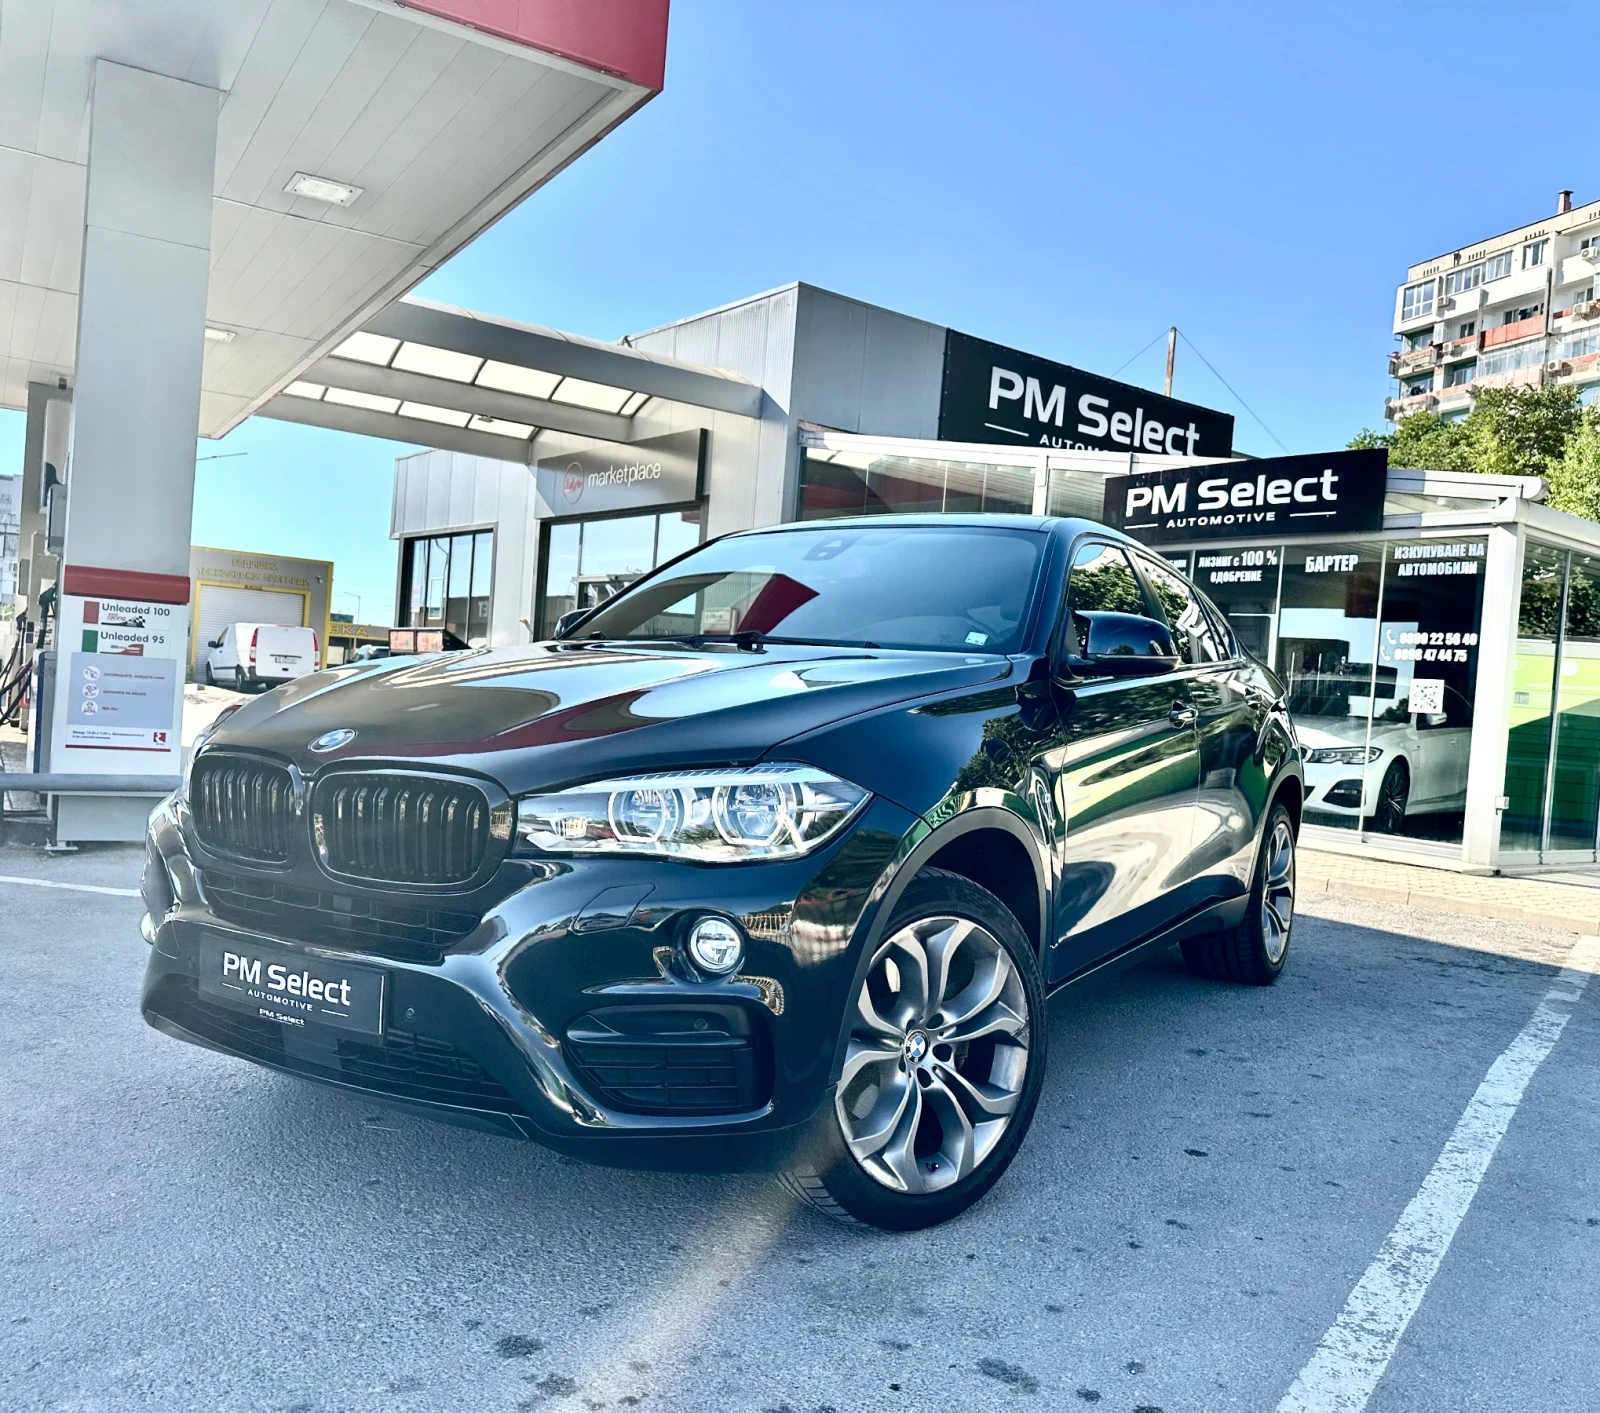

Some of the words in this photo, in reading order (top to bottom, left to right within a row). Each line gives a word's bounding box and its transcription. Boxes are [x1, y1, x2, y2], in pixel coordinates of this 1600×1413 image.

[989, 366, 1066, 427] PM
[1077, 394, 1200, 457] Select
[588, 461, 661, 487] marketplace
[1125, 482, 1188, 517] PM
[1198, 469, 1339, 510] Select
[1166, 511, 1276, 529] AUTOMOTIVE
[1198, 556, 1232, 568] ЛИЗИНГ
[1241, 550, 1264, 566] 100
[1266, 549, 1278, 566] %
[1394, 544, 1467, 560] ИЗКУПУВАНЕ
[1468, 543, 1485, 556] НА
[1305, 554, 1359, 573] БАРТЕР
[1397, 561, 1478, 576] АВТОМОБИЛИ
[1210, 570, 1263, 584] ОДОБРЕНИЕ
[102, 602, 151, 615] Unleaded
[153, 607, 171, 617] 100
[100, 631, 150, 643] Unleaded
[152, 635, 165, 644] 95
[223, 951, 262, 986] PM
[267, 964, 352, 1007] Select
[247, 988, 314, 1012] AUTOMOTIVE
[259, 1008, 275, 1018] PM
[275, 1013, 305, 1026] Select
